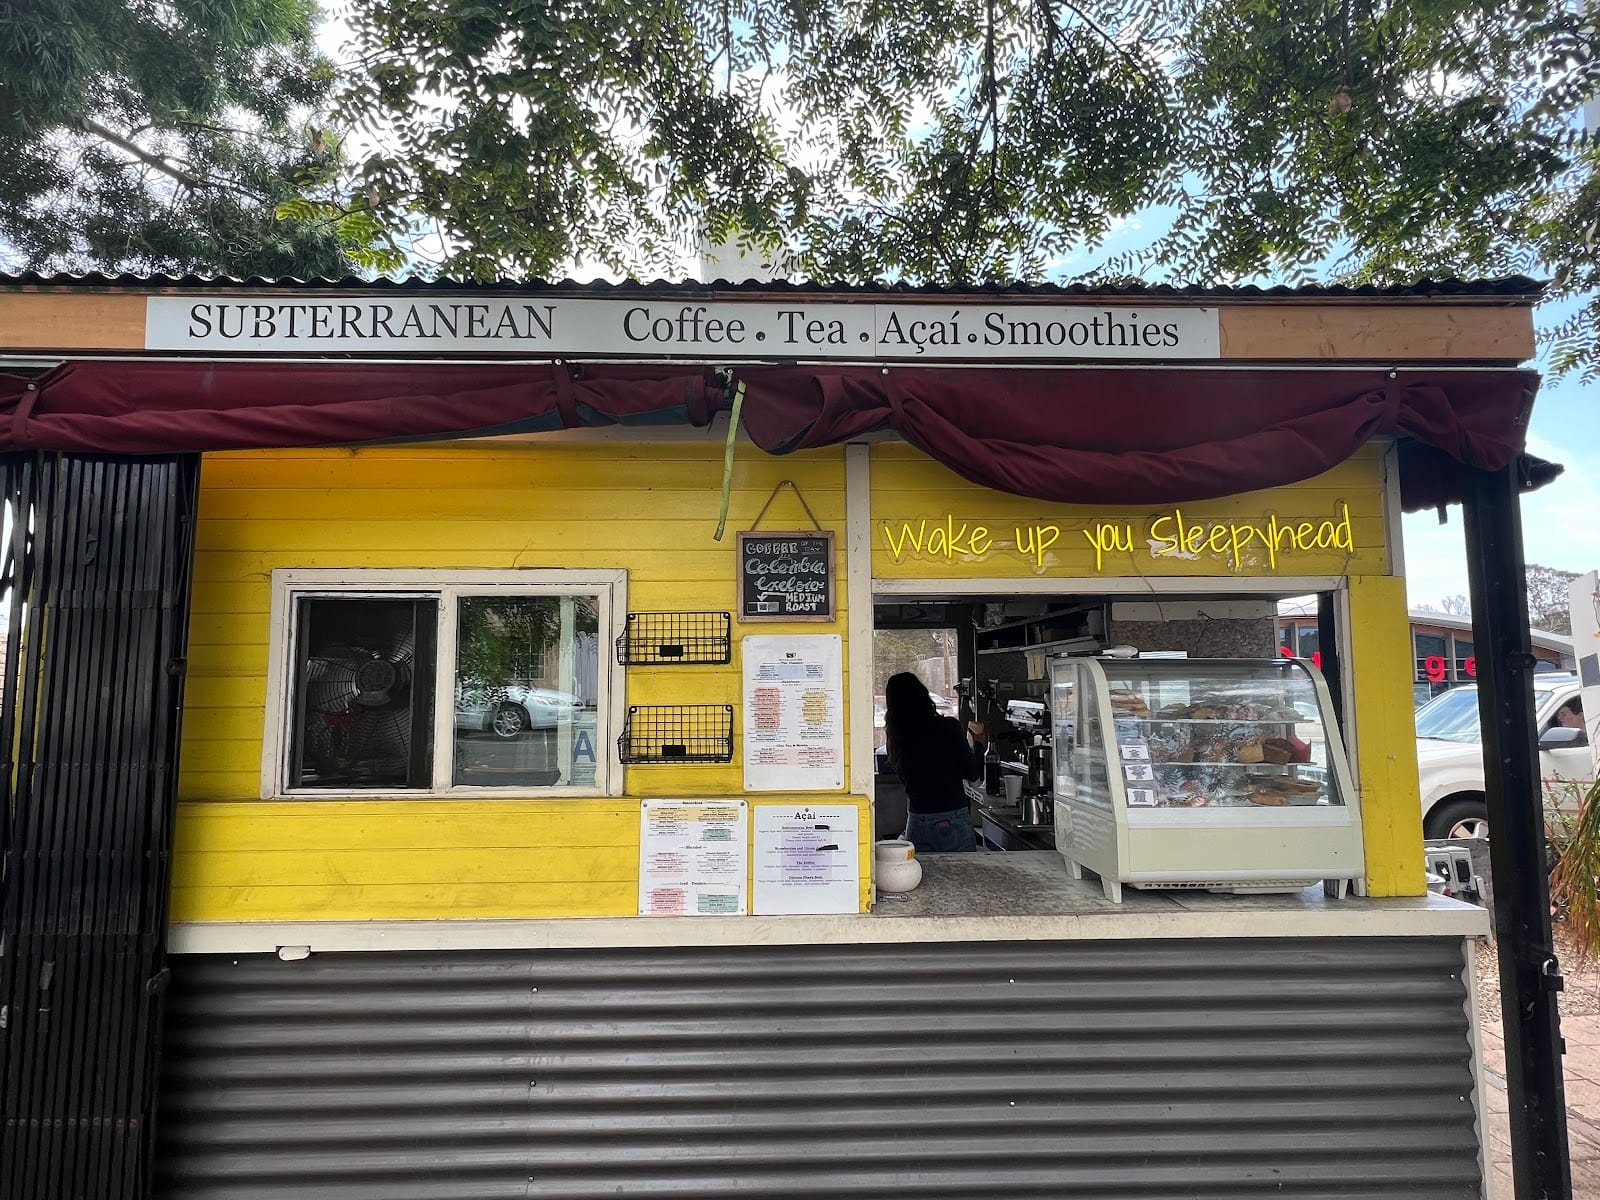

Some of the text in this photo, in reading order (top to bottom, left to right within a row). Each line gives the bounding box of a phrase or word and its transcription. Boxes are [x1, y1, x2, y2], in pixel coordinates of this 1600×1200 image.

[189, 304, 557, 339] SUBTERRANEAN
[623, 307, 1179, 354] Coffee Tea Açaí Smoothies
[745, 542, 799, 555] COFFEE
[884, 503, 1354, 572] Wake up you Sleepyhead
[745, 556, 826, 575] Colombia
[785, 592, 826, 603] MEDIUM
[785, 602, 818, 612] ROAST
[573, 730, 597, 763] A
